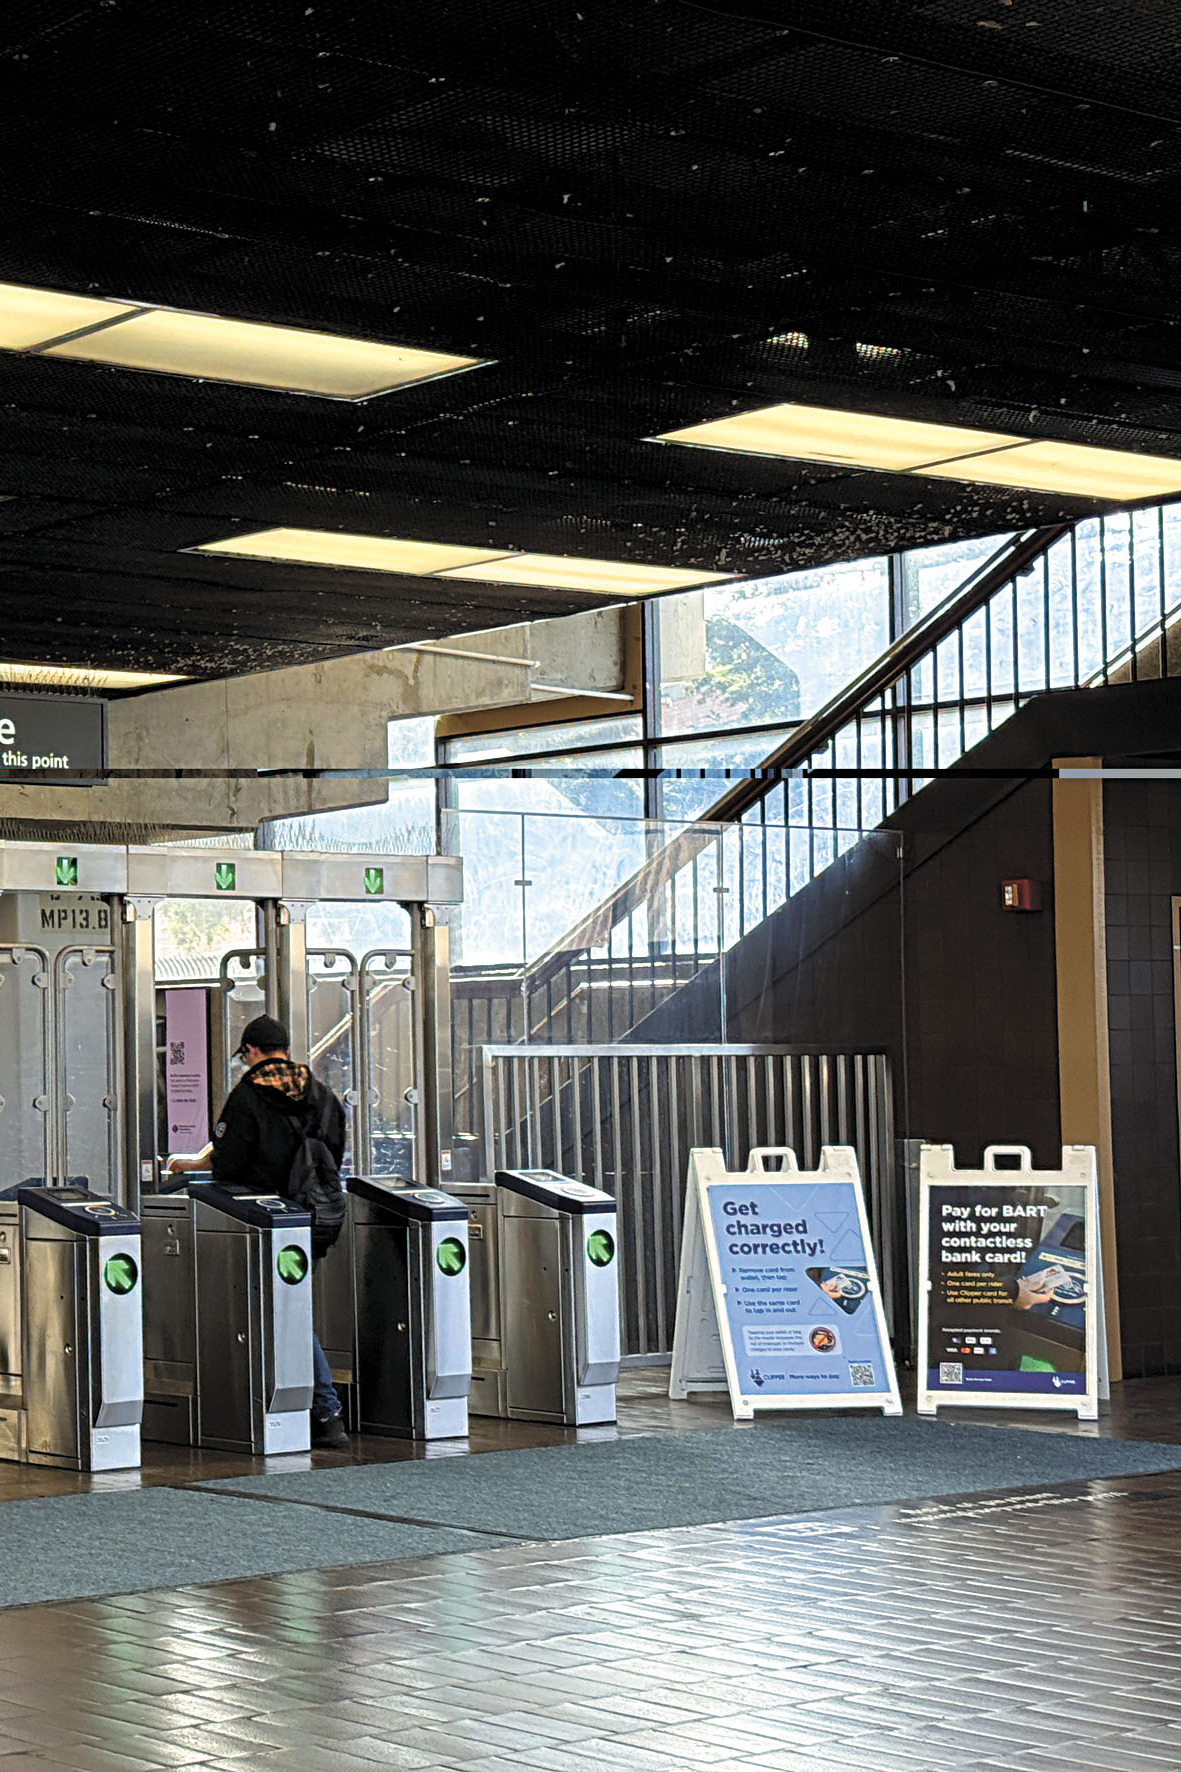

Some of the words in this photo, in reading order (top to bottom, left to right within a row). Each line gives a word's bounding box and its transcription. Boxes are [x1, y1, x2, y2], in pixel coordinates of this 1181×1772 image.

[2, 750, 28, 767] this
[32, 752, 70, 769] point
[722, 1201, 759, 1216] Get
[941, 1205, 970, 1219] Pay
[975, 1204, 999, 1217] for
[1002, 1205, 1048, 1217] BART
[725, 1219, 808, 1238] charged
[941, 1220, 977, 1233] with
[981, 1222, 1017, 1234] your
[728, 1238, 826, 1257] correctly!
[941, 1235, 1033, 1248] contactless
[941, 1250, 981, 1263] bank
[985, 1251, 1027, 1263] card!
[982, 1271, 996, 1279] only
[959, 1289, 982, 1298] Clipper
